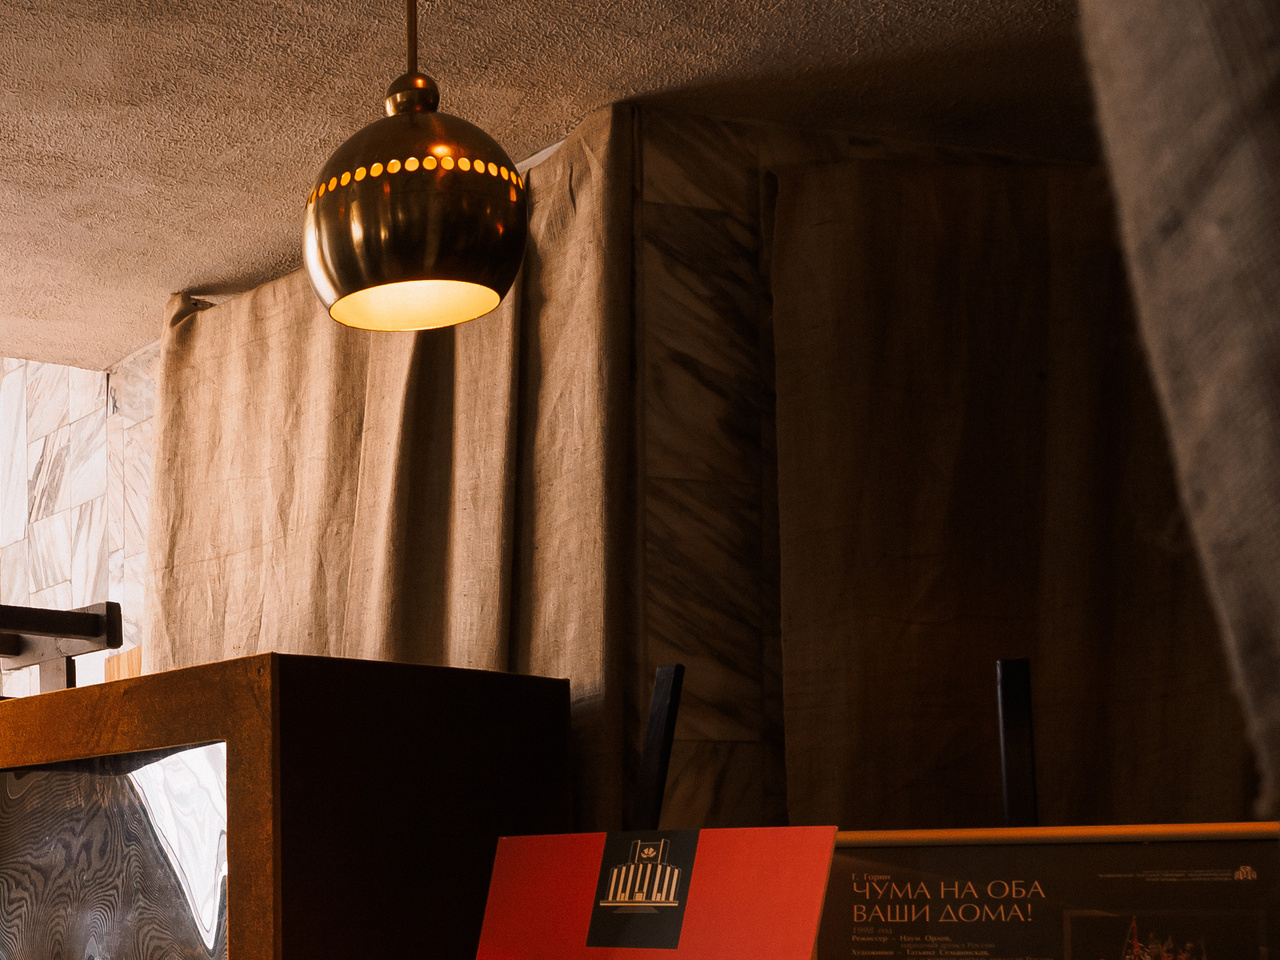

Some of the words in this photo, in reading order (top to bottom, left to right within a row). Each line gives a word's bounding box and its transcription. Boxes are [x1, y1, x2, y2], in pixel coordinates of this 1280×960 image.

[853, 882, 931, 899] ЧУМА
[940, 881, 978, 899] НА
[987, 880, 1046, 898] ОБА
[853, 904, 930, 922] ВАШИ
[939, 904, 1032, 922] ДОМА!
